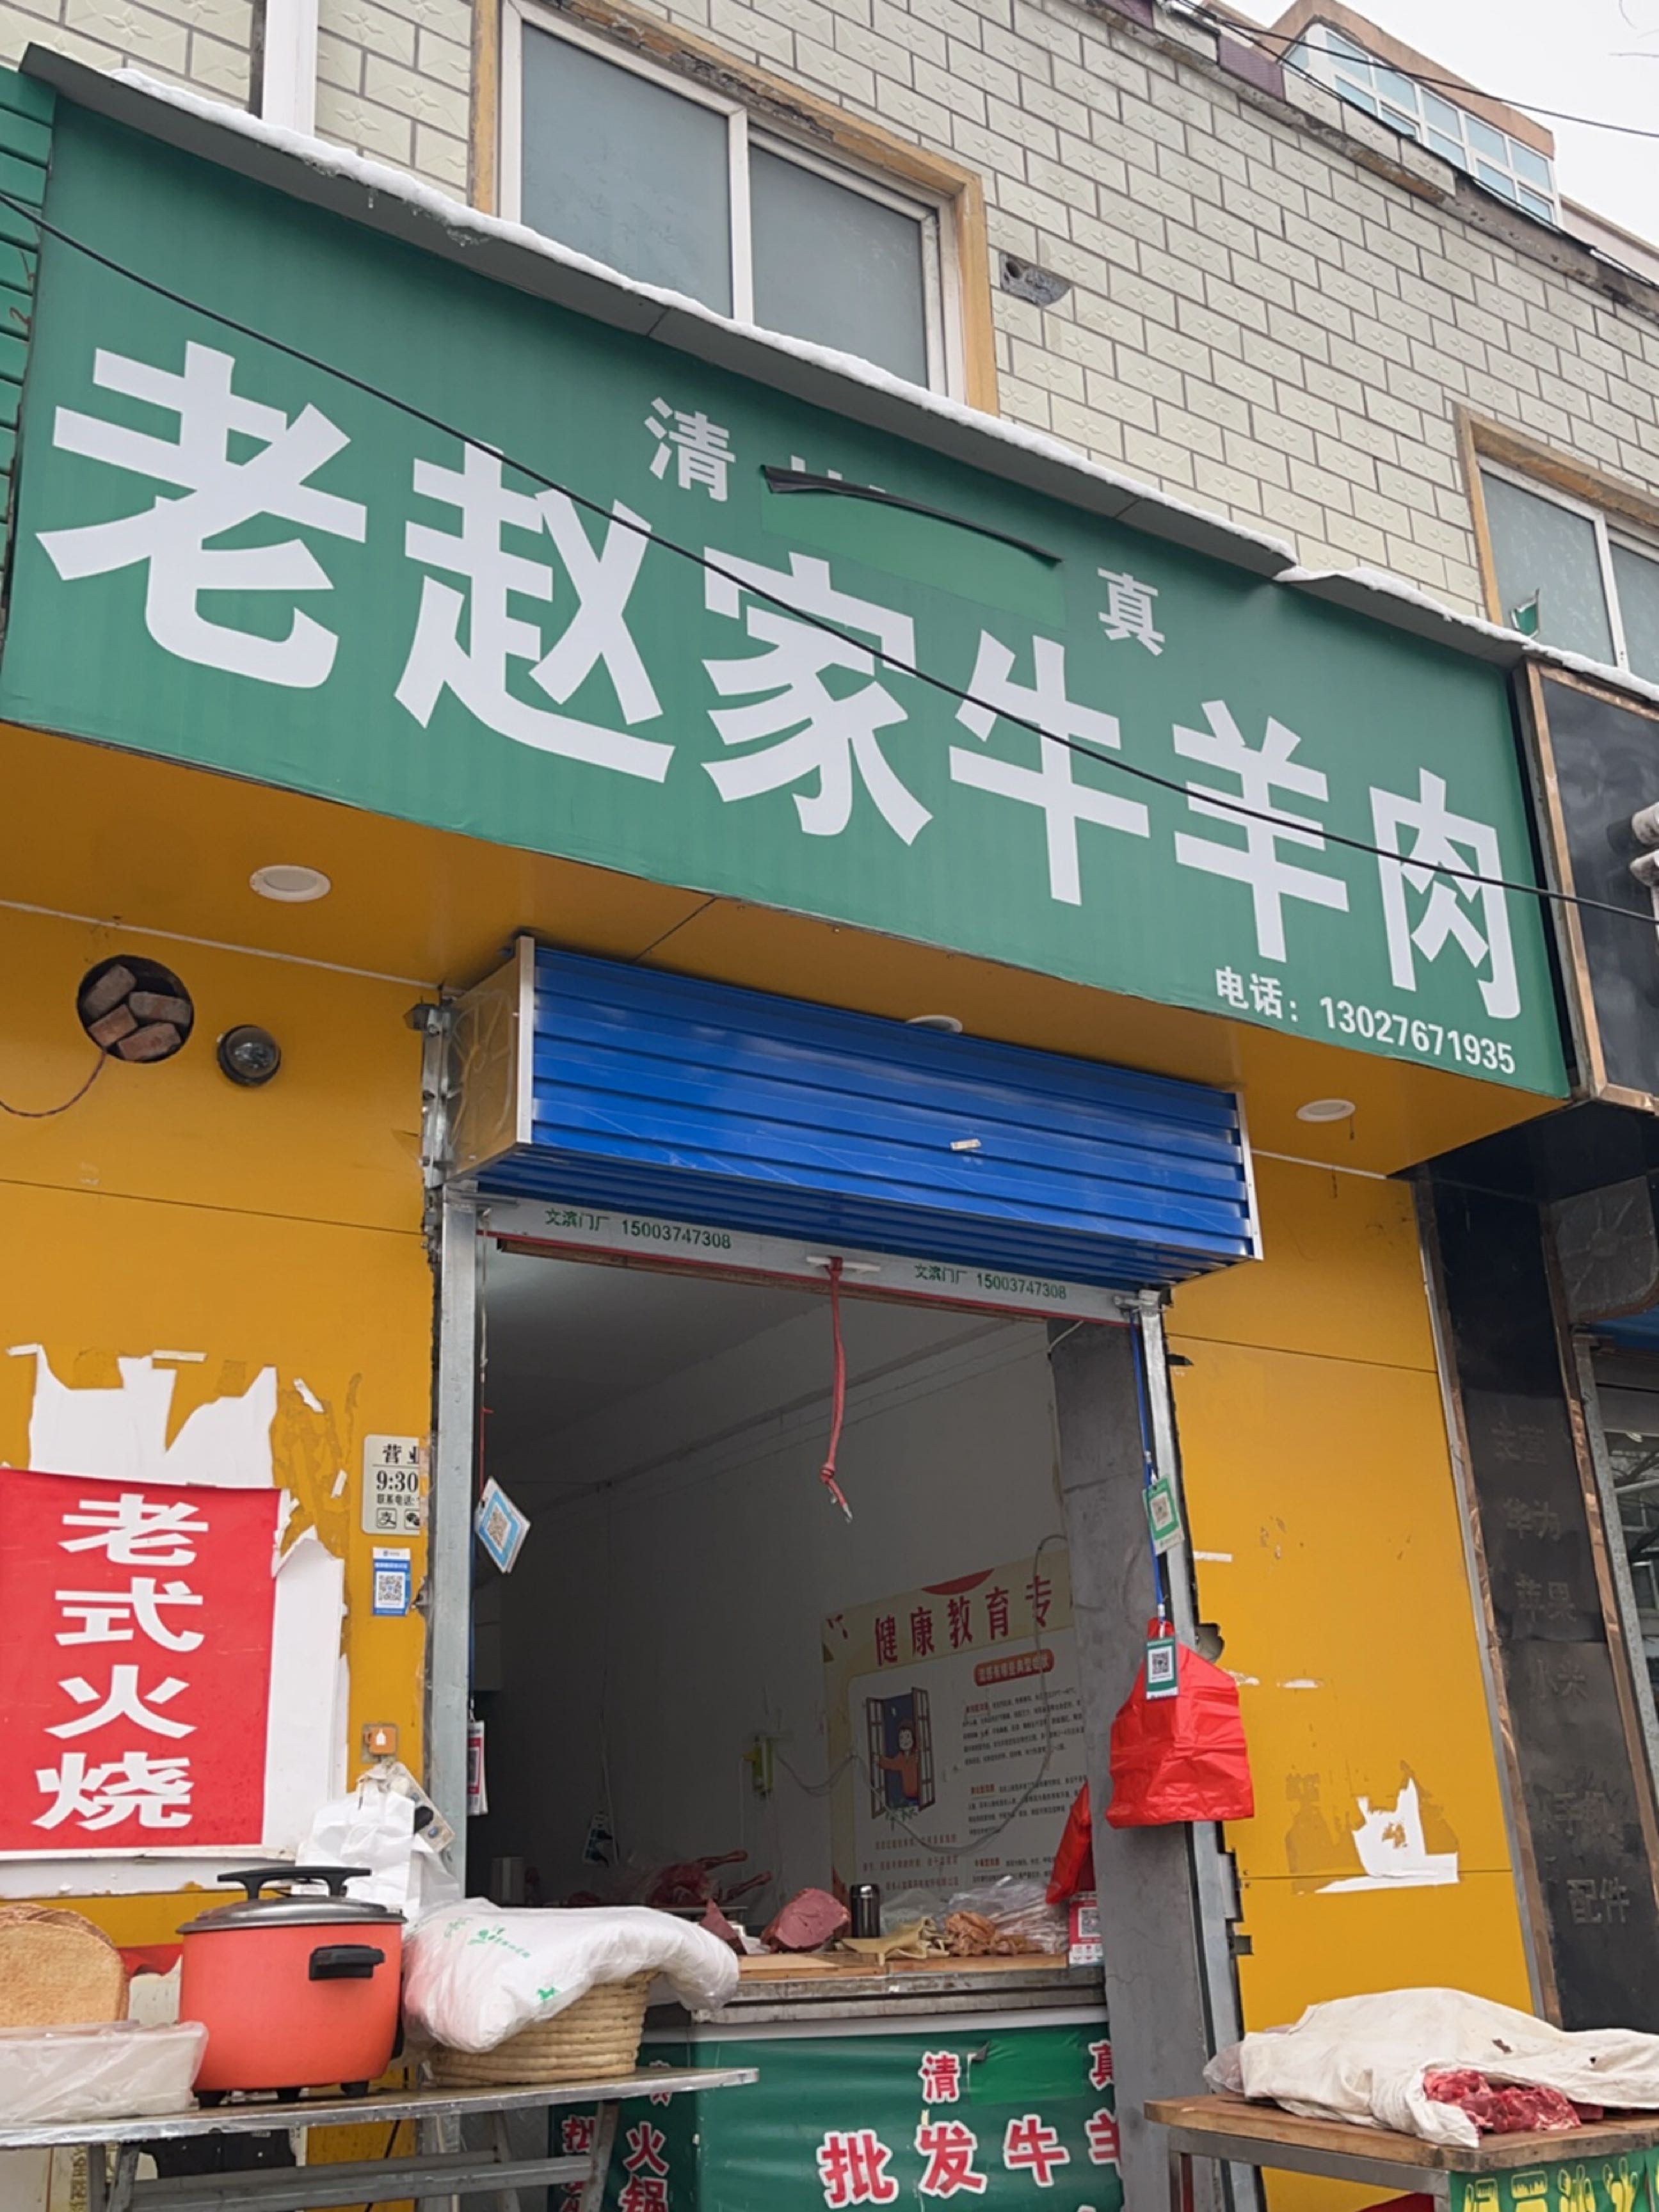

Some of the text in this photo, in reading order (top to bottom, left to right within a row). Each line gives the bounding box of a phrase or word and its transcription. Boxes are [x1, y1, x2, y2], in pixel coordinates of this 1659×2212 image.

[645, 397, 735, 501] 清
[1098, 568, 1165, 655] 真
[36, 340, 1522, 1019] 老赵家牛羊肉
[1320, 997, 1515, 1074] 13027671935
[621, 1219, 731, 1249] 15003747308
[977, 1272, 1067, 1299] 15003747308
[376, 1470, 419, 1493] 9:30
[32, 1493, 209, 1830] 老式火烧
[874, 1575, 1054, 1665] 健康教育专
[920, 2051, 959, 2103] 清
[618, 2121, 669, 2212] 火锅
